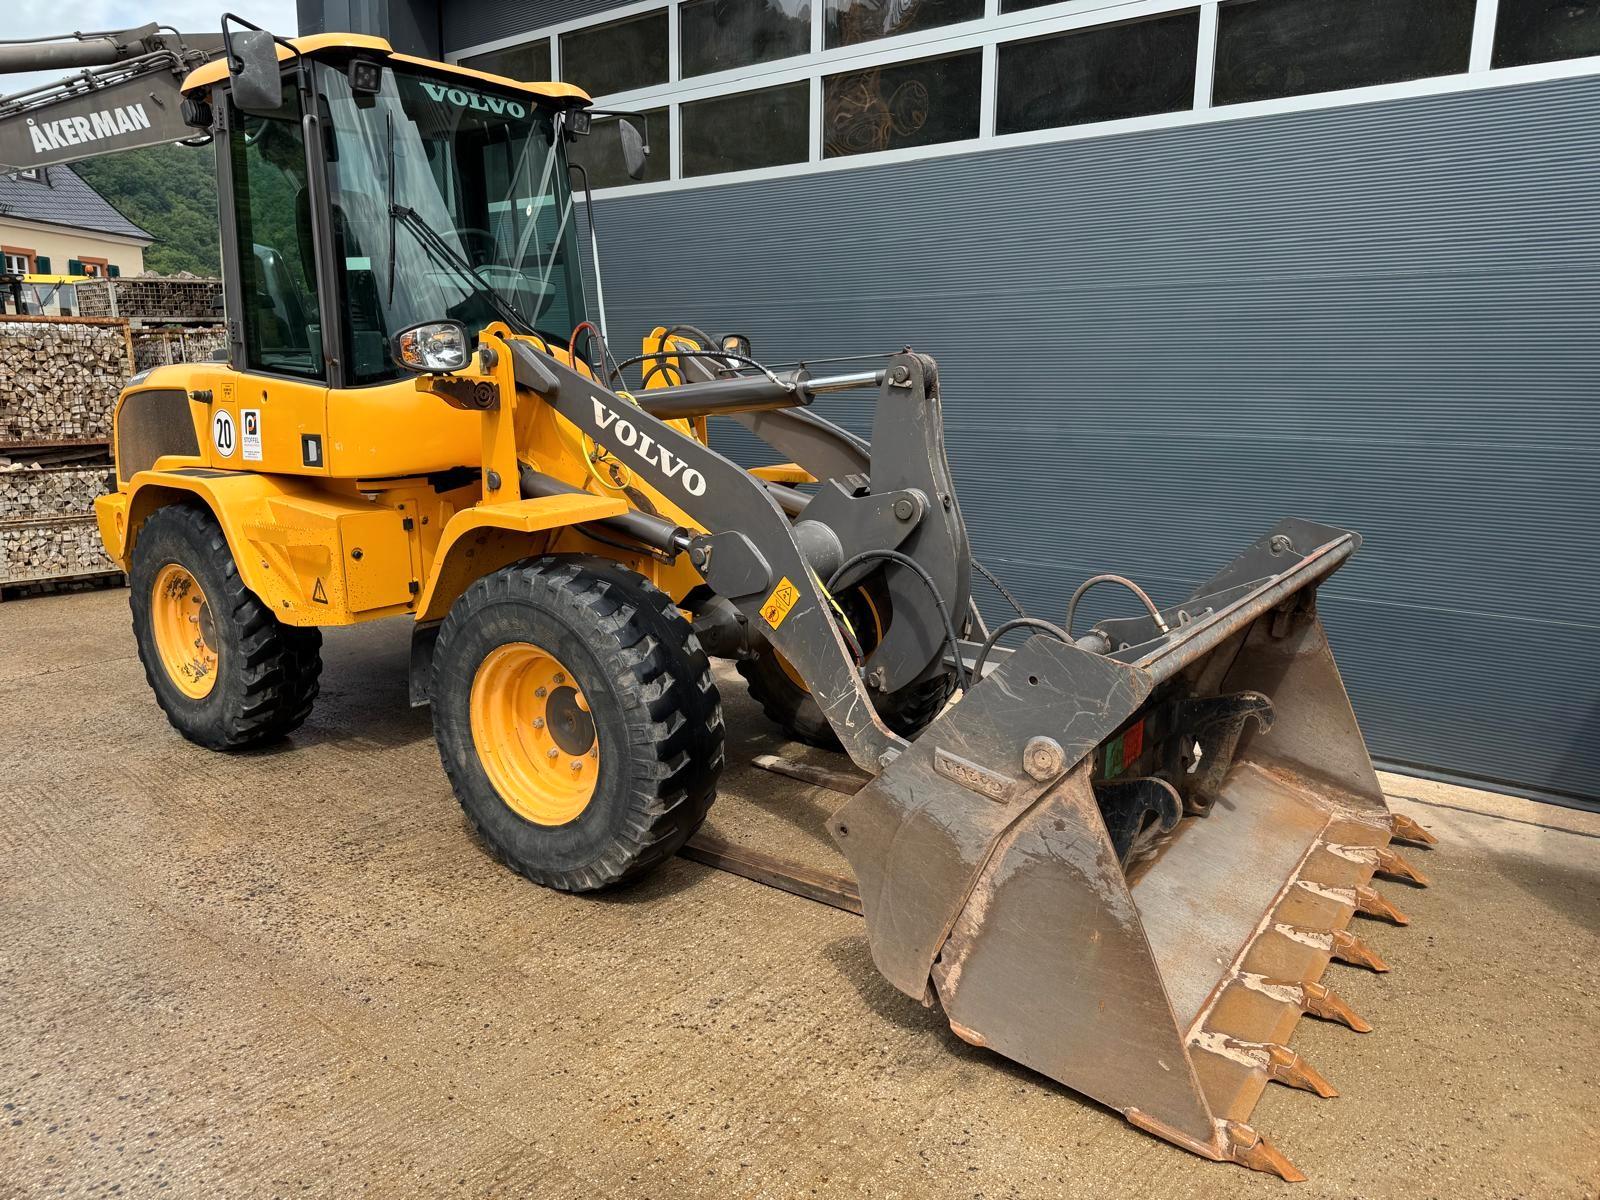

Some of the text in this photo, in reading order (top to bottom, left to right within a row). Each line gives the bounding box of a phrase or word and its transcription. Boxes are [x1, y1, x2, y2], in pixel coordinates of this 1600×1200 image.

[419, 82, 526, 119] VOLVO
[26, 103, 151, 153] ÅKERMAN
[216, 418, 232, 449] 20
[590, 395, 707, 497] VOLVO
